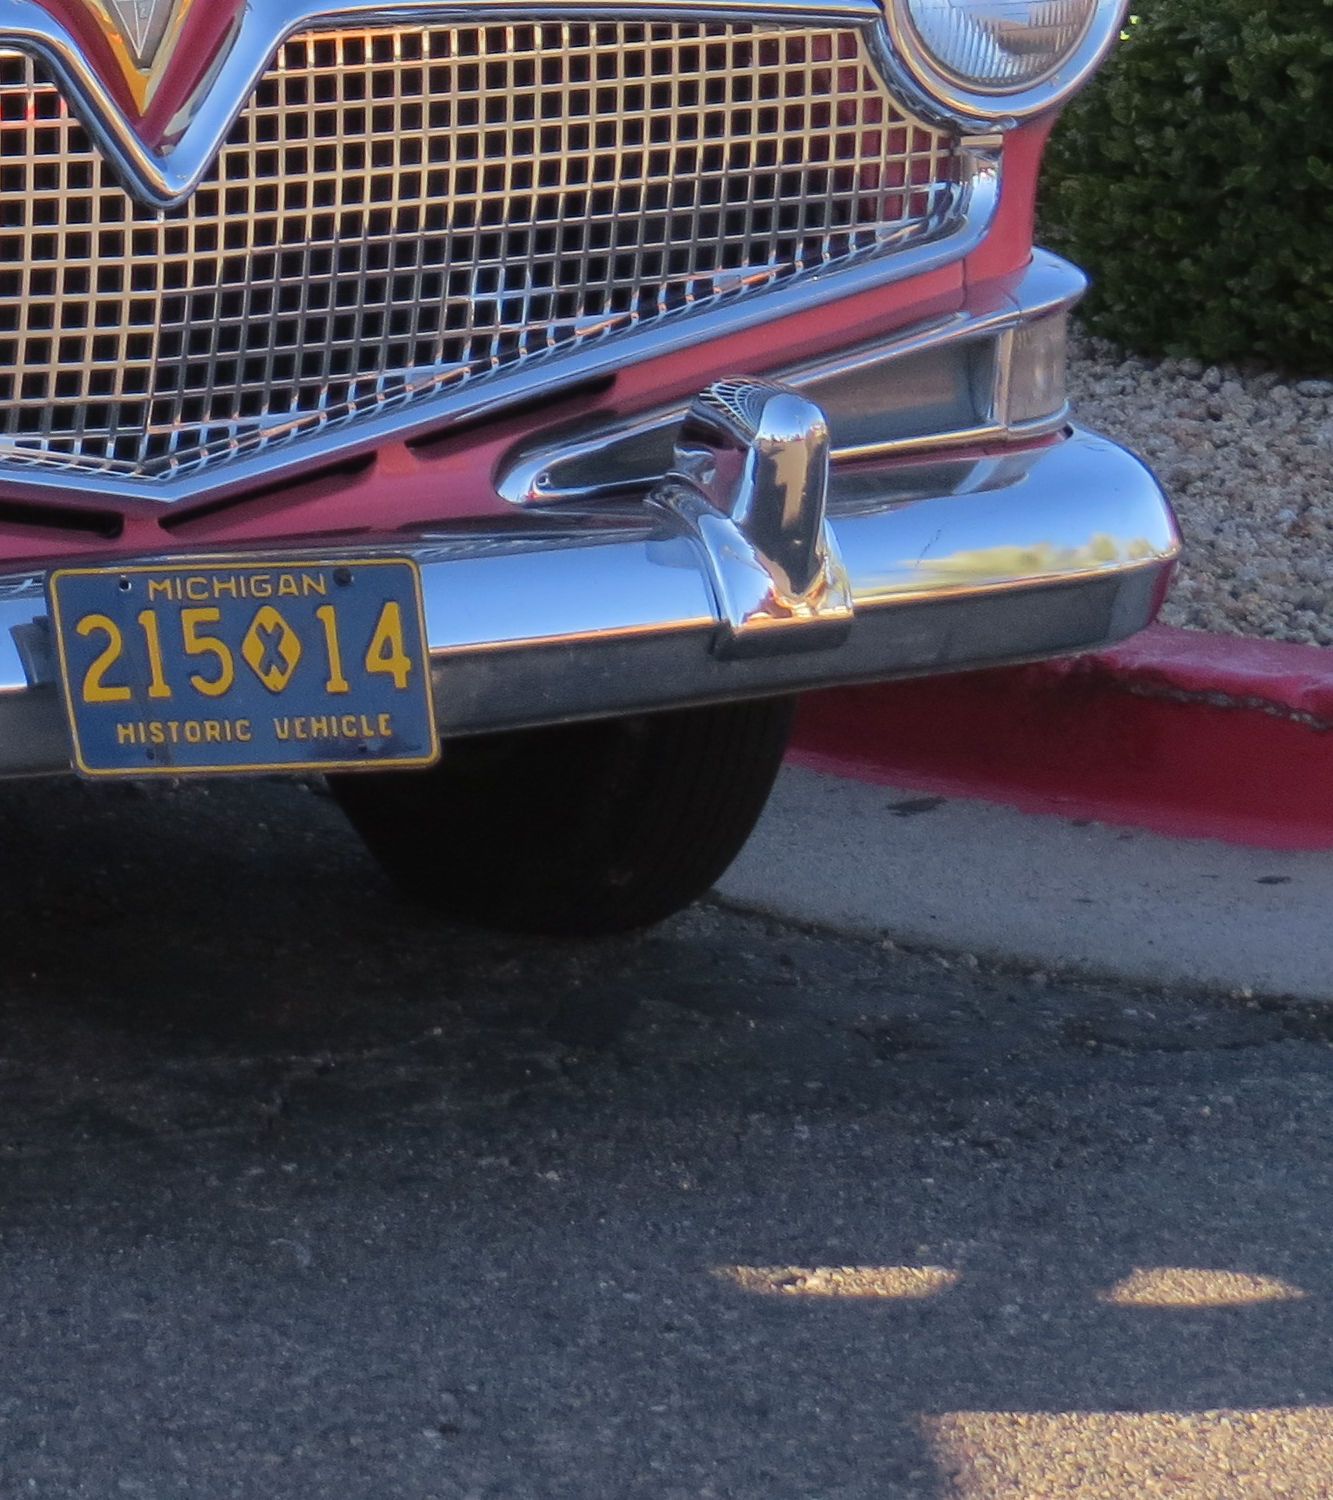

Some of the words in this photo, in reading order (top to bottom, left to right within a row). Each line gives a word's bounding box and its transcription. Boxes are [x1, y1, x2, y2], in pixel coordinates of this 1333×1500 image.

[148, 573, 327, 601] MICHIGAN
[117, 717, 252, 744] HISTORIC
[273, 712, 394, 740] VEHICLE
